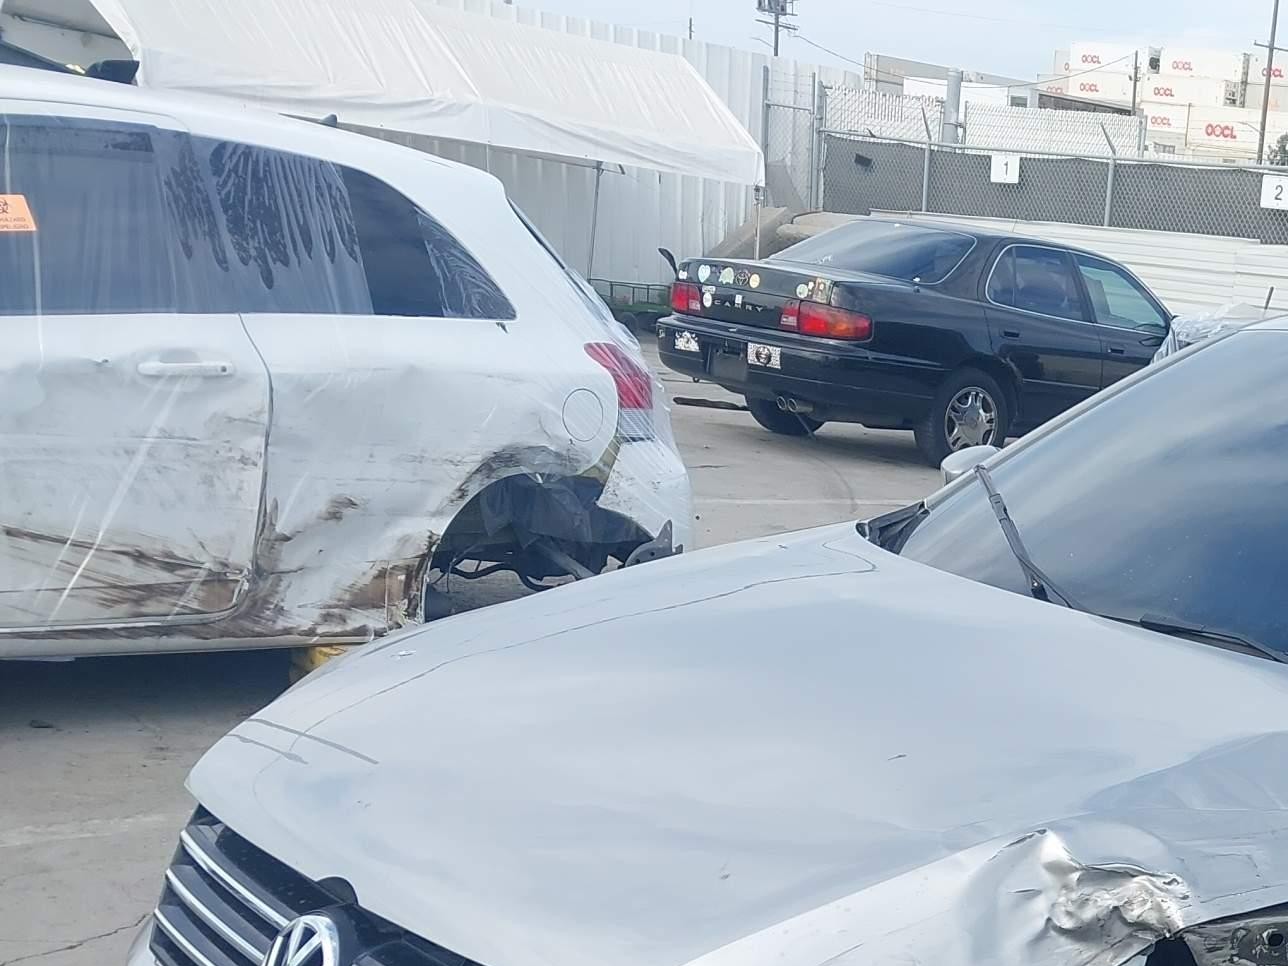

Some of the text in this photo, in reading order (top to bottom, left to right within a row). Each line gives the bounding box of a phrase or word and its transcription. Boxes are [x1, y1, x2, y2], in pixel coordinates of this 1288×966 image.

[1081, 54, 1101, 64] OOCL
[1172, 61, 1192, 71] OOCL
[1080, 83, 1099, 92] OOCL
[1153, 87, 1174, 97] OOCL
[1150, 116, 1172, 126] OOCL
[1205, 123, 1237, 139] OOCL
[1003, 160, 1009, 176] 1
[1274, 184, 1284, 201] 2
